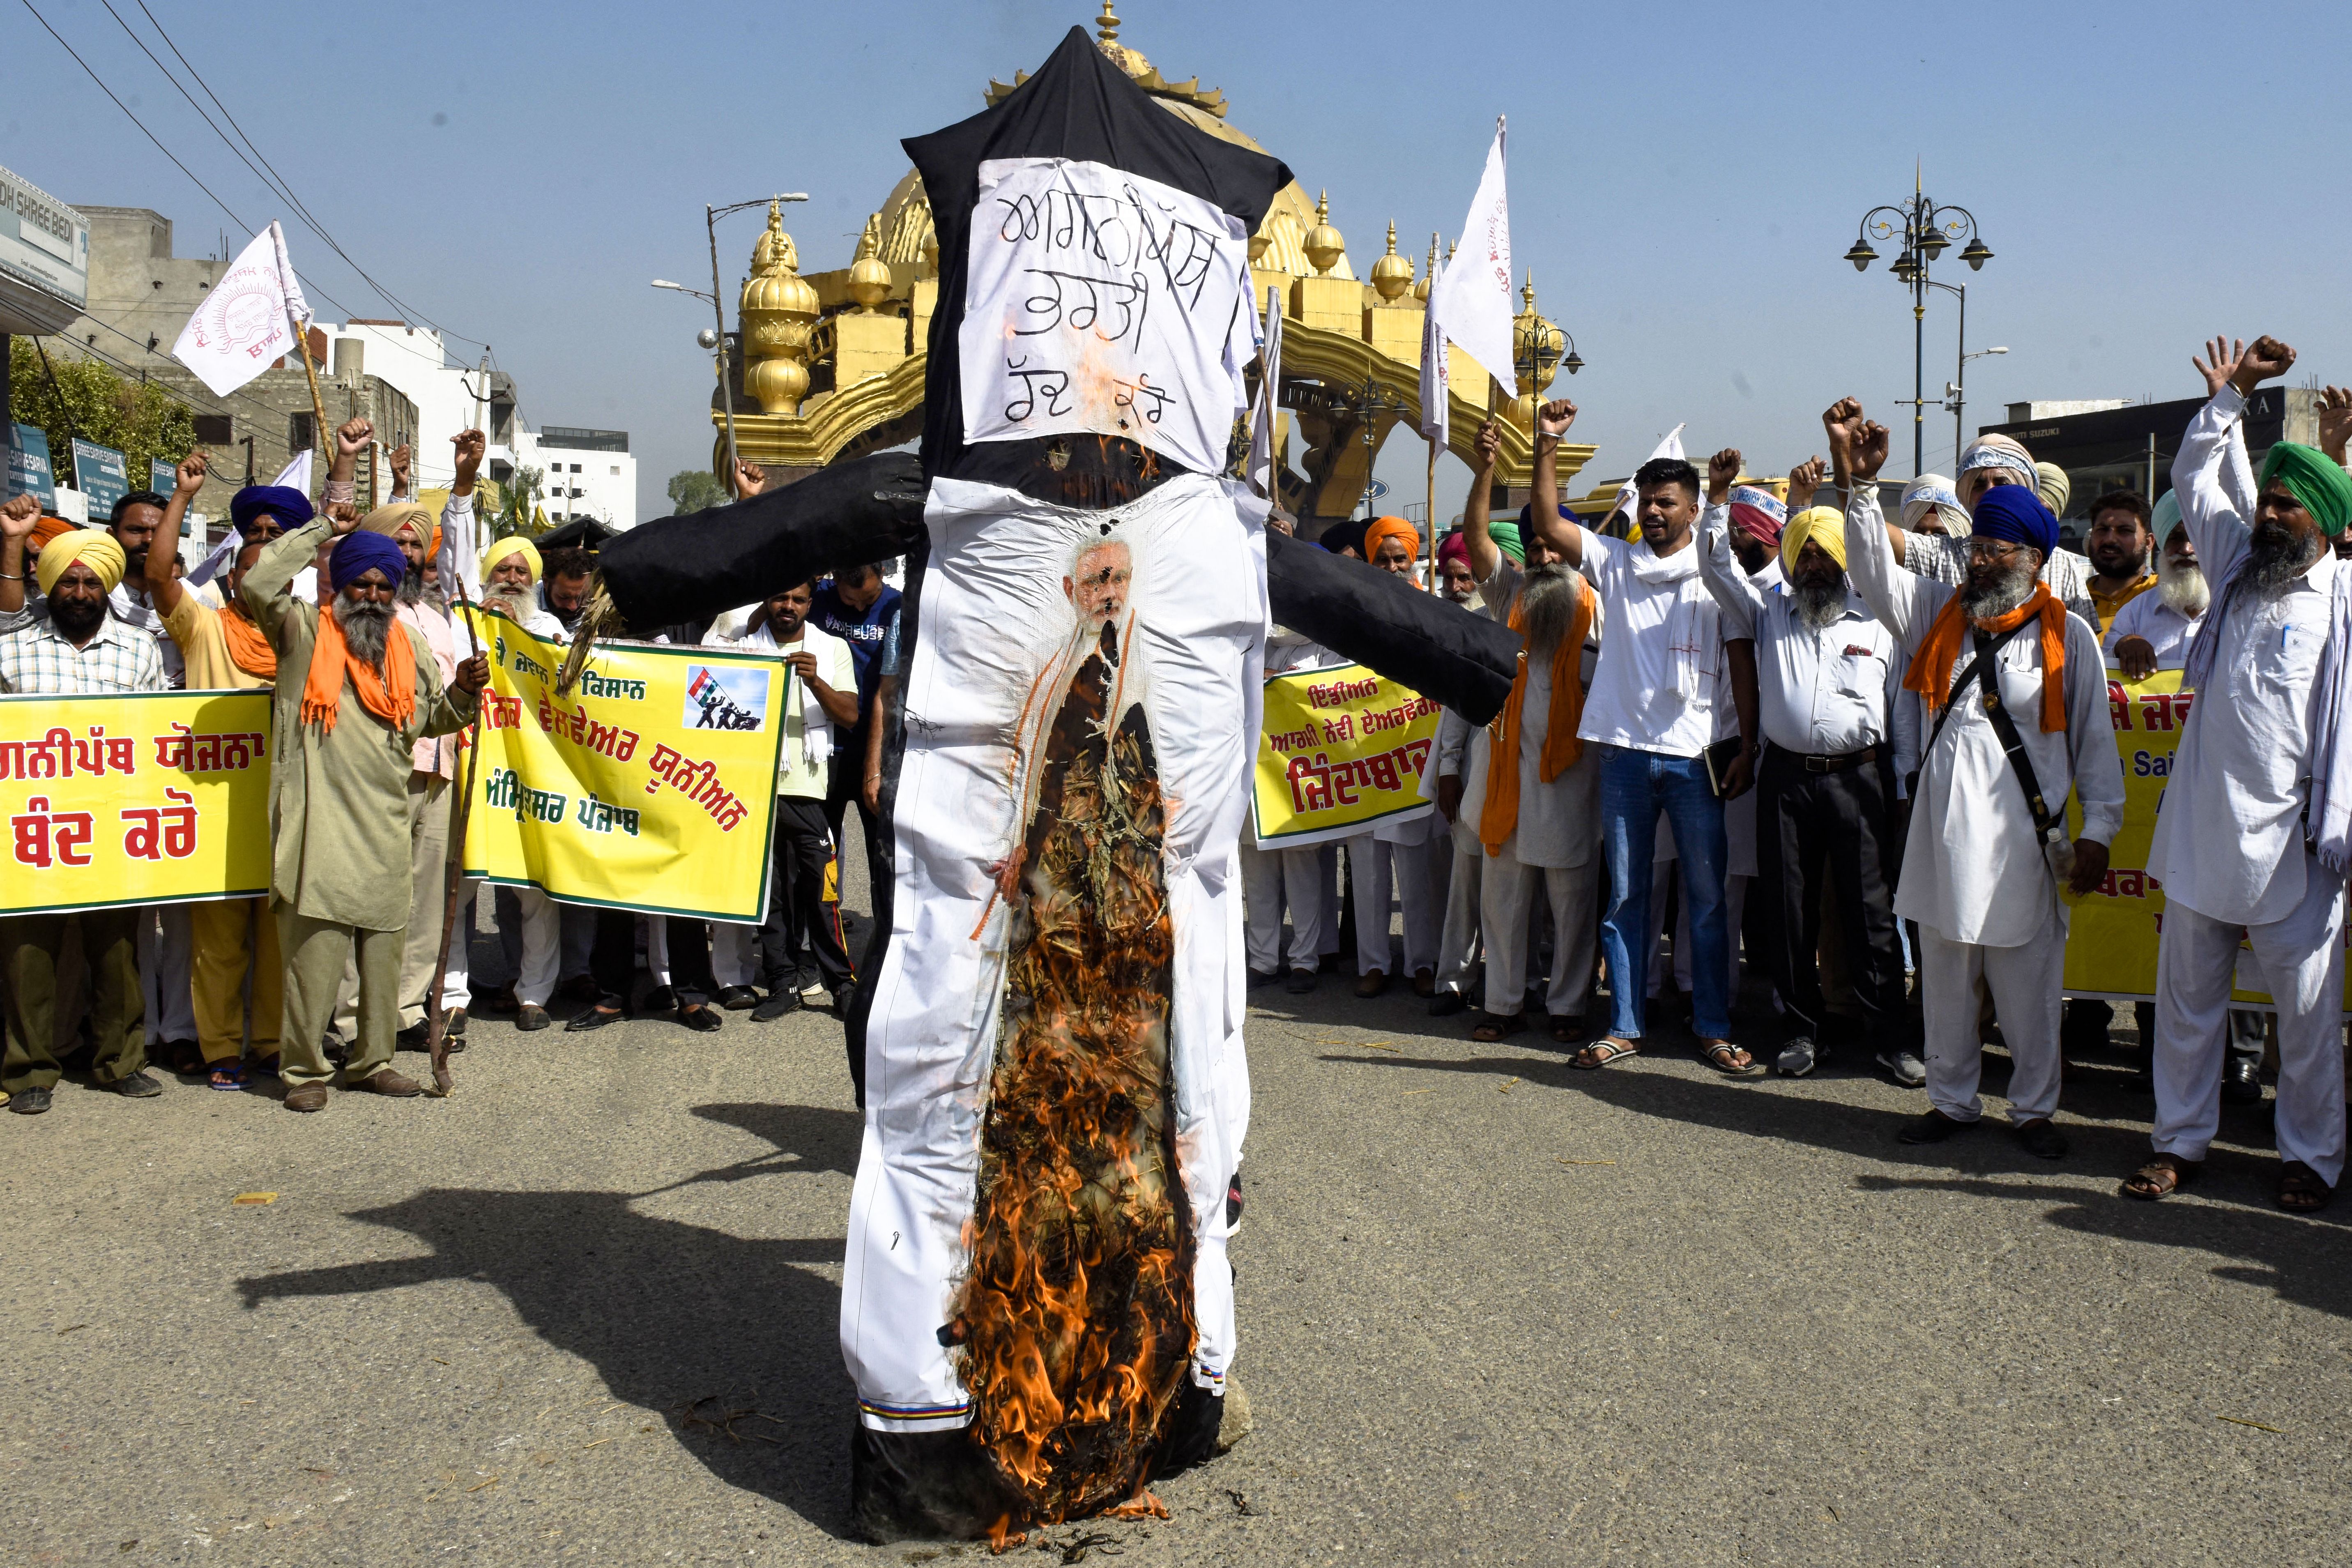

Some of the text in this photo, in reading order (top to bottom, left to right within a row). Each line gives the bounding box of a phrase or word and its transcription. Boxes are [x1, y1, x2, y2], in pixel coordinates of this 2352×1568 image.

[16, 190, 50, 231] SHREE
[52, 210, 74, 244] BEDI
[2005, 427, 2060, 440] RUTI SUZUKI
[1760, 495, 1786, 518] COMMITTEE
[582, 671, 646, 700] ਕਿਸਾਨ
[1307, 677, 1379, 709] ਇੰਡੀਅਨ
[154, 723, 265, 772] ਯੋਜਨਾ
[1270, 723, 1321, 751] ਆਰਮੀ
[1322, 714, 1355, 744] ਨੇਵੀ
[538, 686, 640, 762] ਵੈਲਫੇਅਰ
[645, 743, 748, 832] ਯੂਨੀਅਨ
[11, 788, 198, 868] ਬੰਦ ਕਰੋ
[578, 792, 641, 836] ਪੰਜਾਬ
